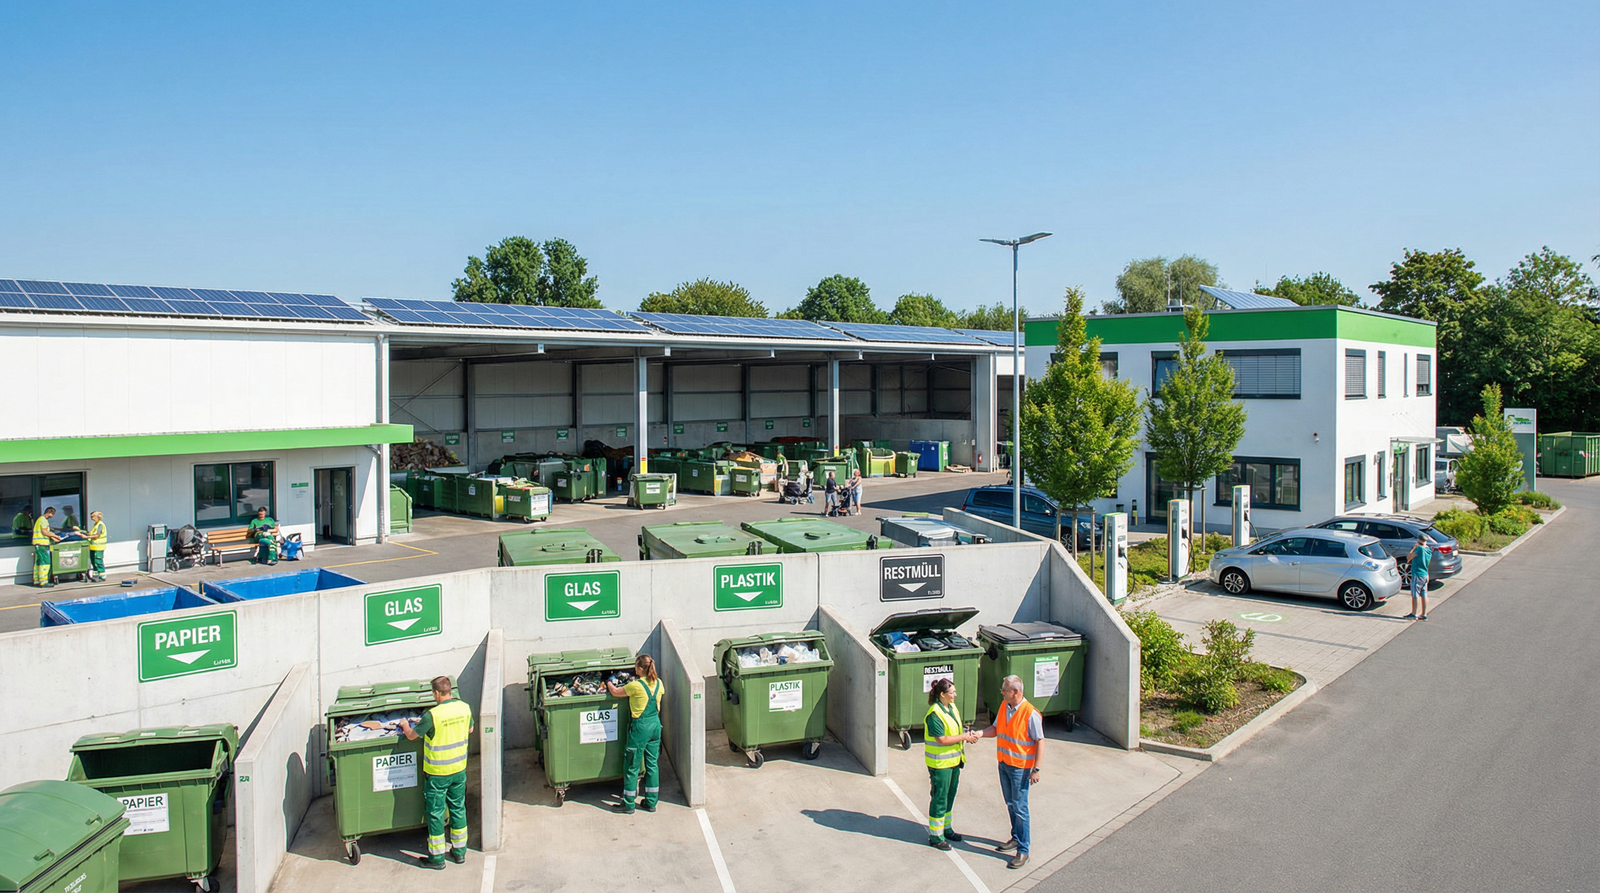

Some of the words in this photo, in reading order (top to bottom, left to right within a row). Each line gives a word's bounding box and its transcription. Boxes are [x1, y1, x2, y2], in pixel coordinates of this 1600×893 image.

[884, 562, 941, 580] RESTMÜLL
[721, 572, 776, 589] PLASTIK
[564, 581, 601, 597] GLAS
[385, 597, 423, 617] GLAS
[155, 625, 221, 650] PAPIER
[770, 681, 800, 691] PLASTIK
[586, 711, 610, 722] GLAS
[376, 754, 413, 768] PAPIER
[122, 796, 164, 809] PAPIER
